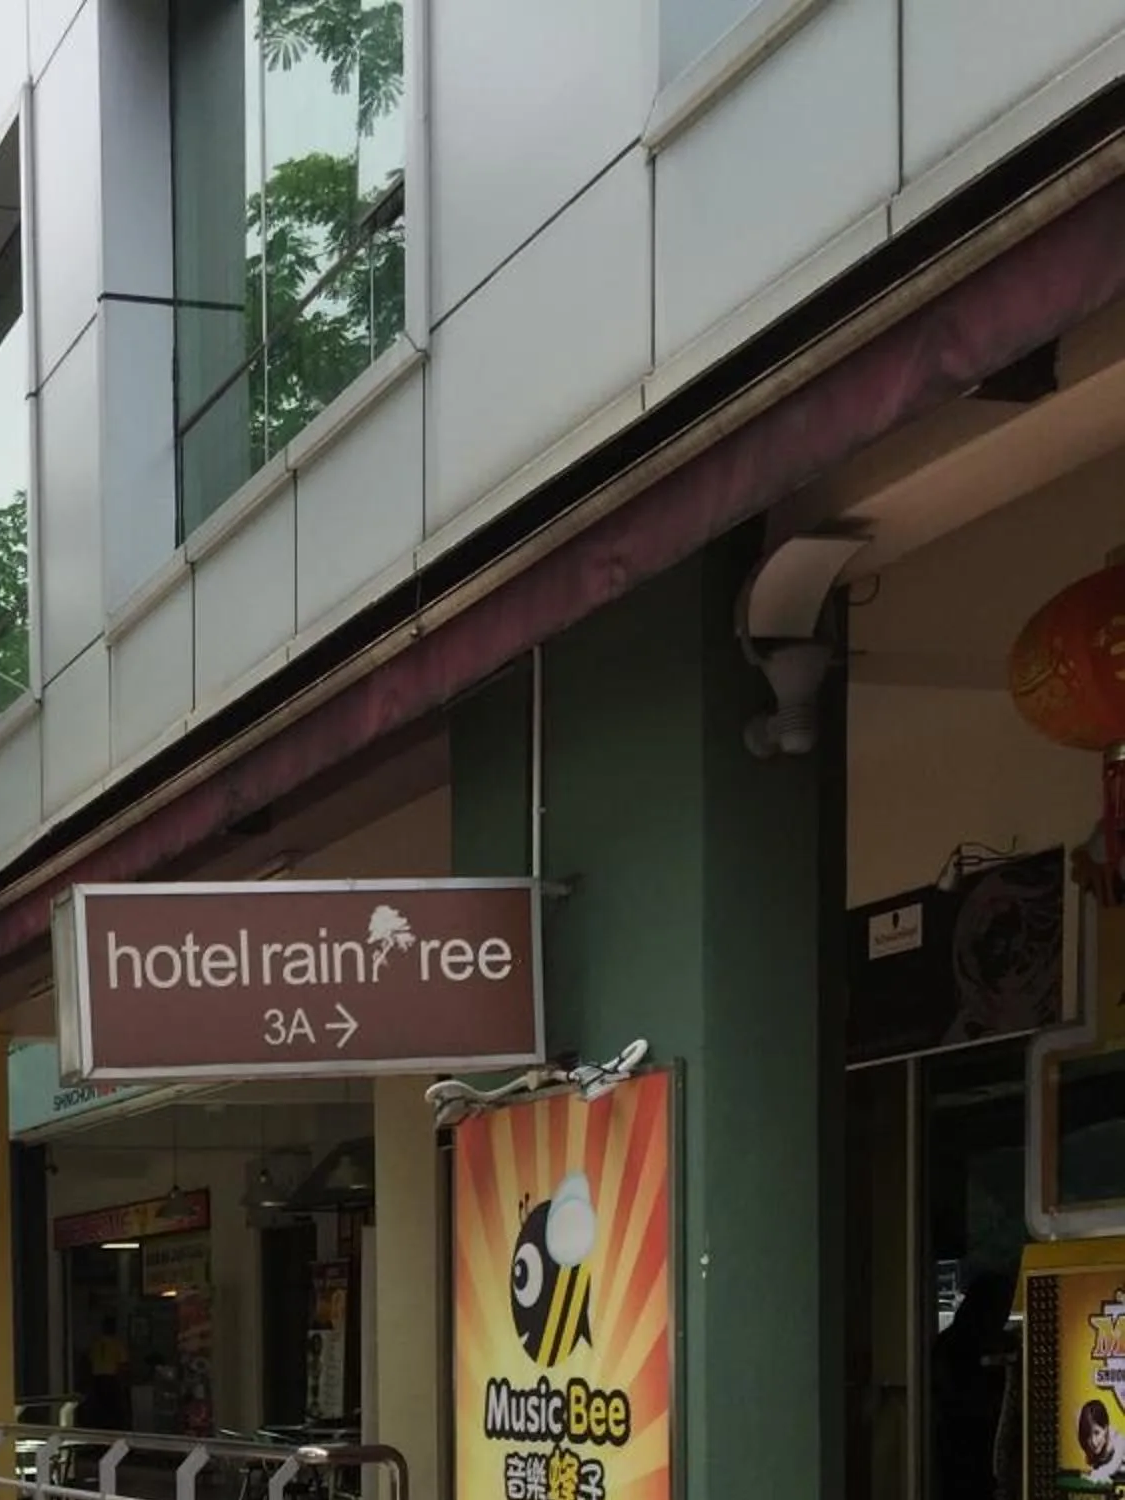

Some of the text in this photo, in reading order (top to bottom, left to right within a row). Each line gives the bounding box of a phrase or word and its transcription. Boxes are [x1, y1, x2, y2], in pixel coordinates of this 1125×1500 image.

[106, 927, 250, 989] hotel
[263, 1006, 316, 1046] 3A
[486, 1379, 629, 1442] Music Bee
